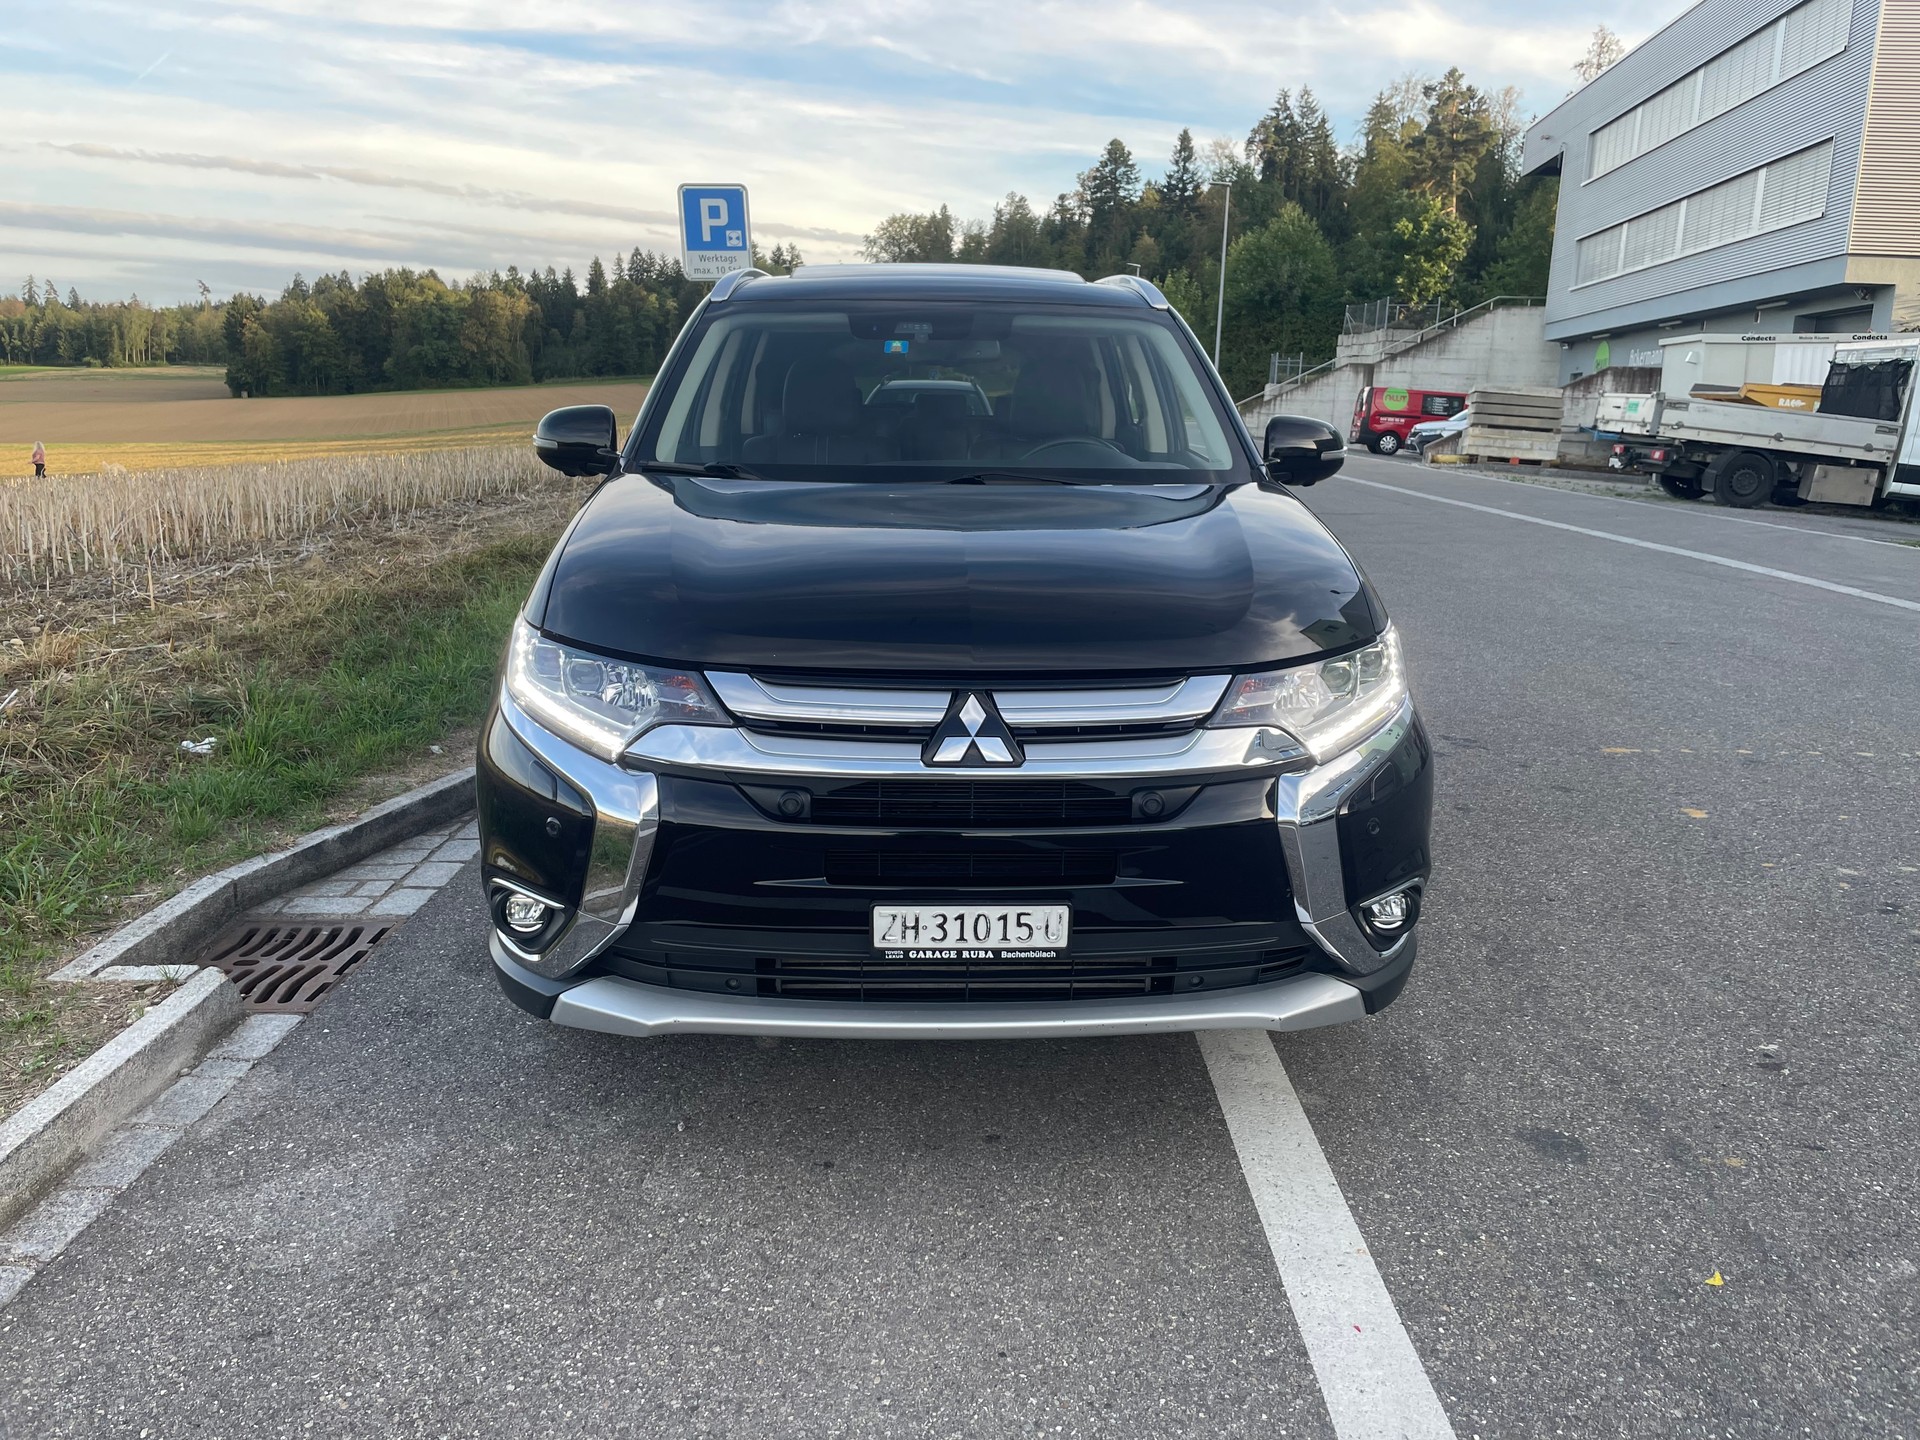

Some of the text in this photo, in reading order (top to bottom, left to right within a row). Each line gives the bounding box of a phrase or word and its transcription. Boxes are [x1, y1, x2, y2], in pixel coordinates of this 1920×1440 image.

[700, 198, 728, 242] P
[698, 254, 737, 264] Werktags
[694, 267, 714, 275] max.
[716, 266, 726, 274] 10
[908, 950, 1057, 959] GARAGE RUBA Bachenbülach
